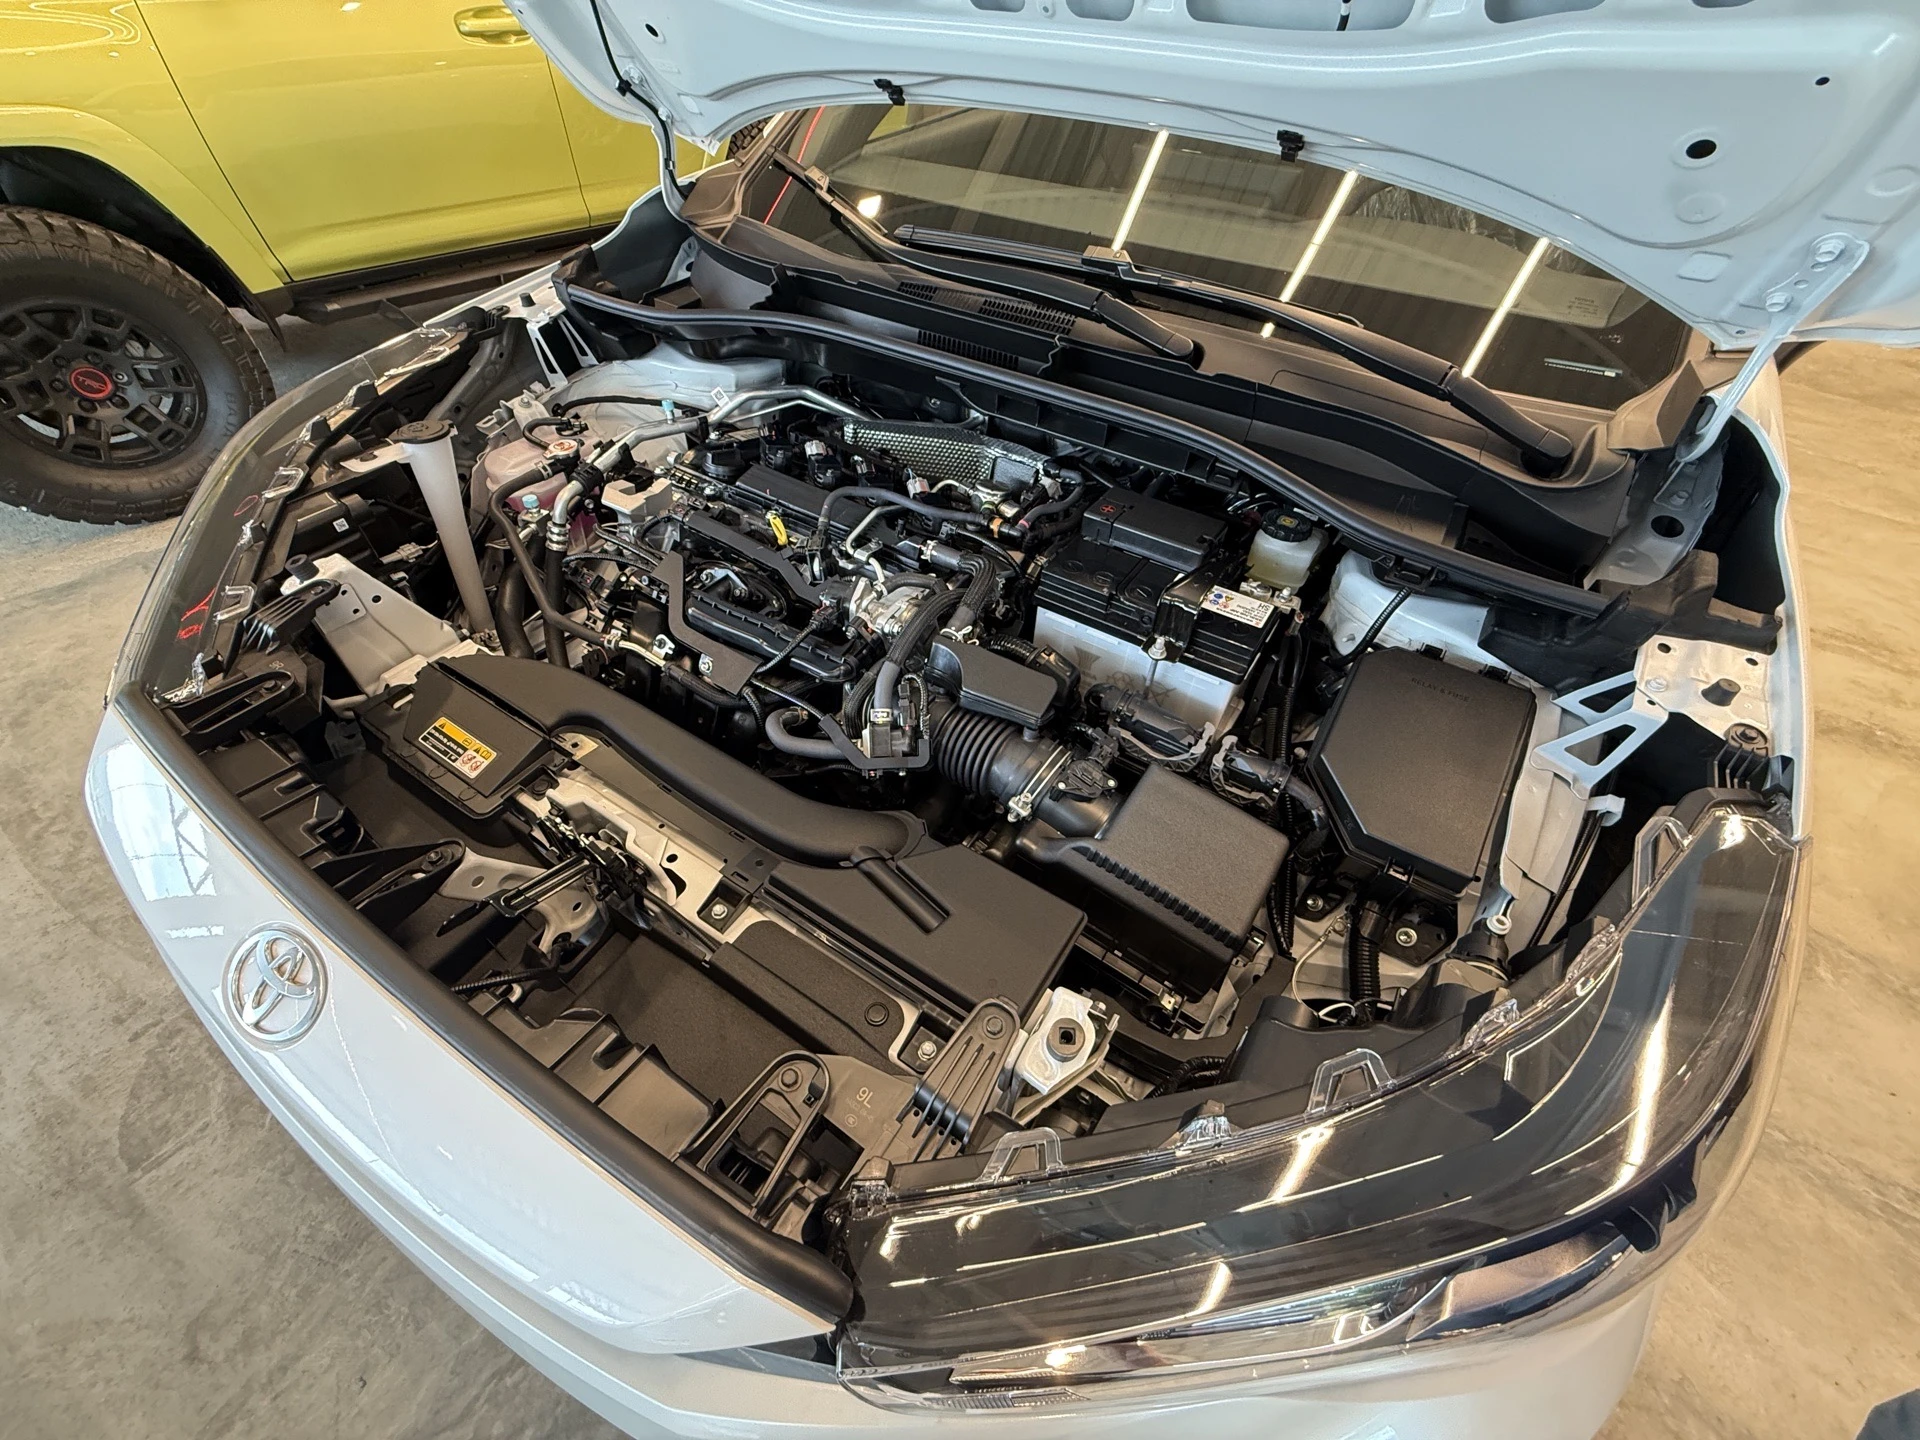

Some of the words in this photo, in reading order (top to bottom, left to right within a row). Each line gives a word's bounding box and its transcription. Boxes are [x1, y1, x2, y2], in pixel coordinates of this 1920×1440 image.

[77, 375, 107, 390] TRD
[1411, 677, 1436, 691] RELAY
[1447, 689, 1470, 702] FUSE
[856, 1086, 873, 1108] 9L
